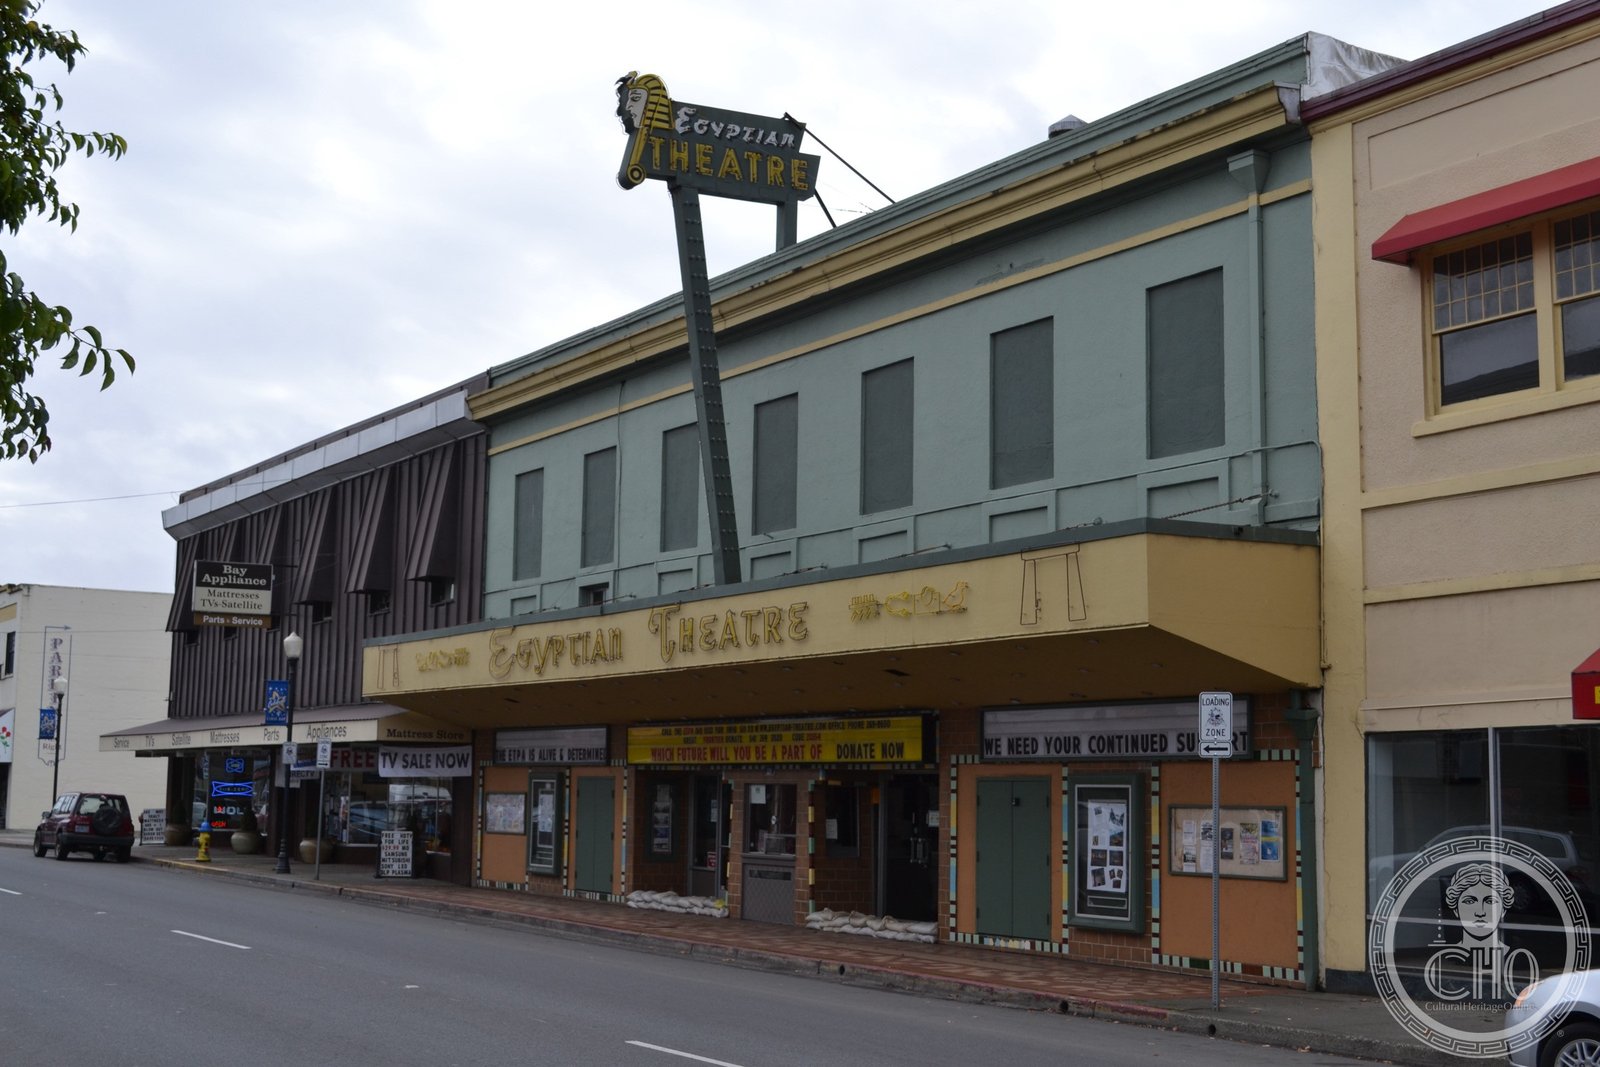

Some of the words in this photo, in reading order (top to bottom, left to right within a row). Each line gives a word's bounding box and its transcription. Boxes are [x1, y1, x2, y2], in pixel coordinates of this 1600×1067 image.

[675, 106, 795, 148] EGYPTIAN
[648, 136, 809, 190] THEATRE
[222, 564, 247, 577] Bay
[201, 573, 267, 586] Appliance
[207, 588, 260, 599] Mattresses
[203, 615, 224, 624] Parts
[231, 616, 263, 626] Service
[488, 626, 625, 679] EGYPTIAN
[648, 601, 809, 663] THEATRE
[1202, 698, 1230, 706] LOADING
[171, 732, 192, 746] Satellite
[263, 727, 280, 741] Parts
[306, 725, 347, 742] Appliances
[386, 728, 433, 739] Mattress
[436, 729, 465, 740] Store
[1205, 728, 1226, 737] ZONE
[985, 738, 1001, 755] WE
[1007, 737, 1039, 755] NEED
[1044, 735, 1081, 754] YOUR
[1088, 733, 1168, 753] CONTINUED
[1177, 731, 1248, 753] SURT
[331, 750, 373, 768] FREE
[508, 748, 526, 761] ETPA
[528, 748, 535, 760] IS
[539, 747, 556, 760] ALIVE
[651, 747, 674, 761] WHICH
[677, 747, 707, 761] FUTURE
[709, 746, 729, 760] WILL
[733, 745, 751, 760] YOU
[755, 745, 767, 760] BE
[771, 744, 777, 760] A
[781, 745, 805, 760] PART
[810, 744, 822, 760] OF
[837, 743, 875, 759] DONATE
[881, 742, 904, 759] NOW
[381, 752, 398, 769] TV
[402, 752, 431, 769] SALE
[435, 752, 470, 769] NOW
